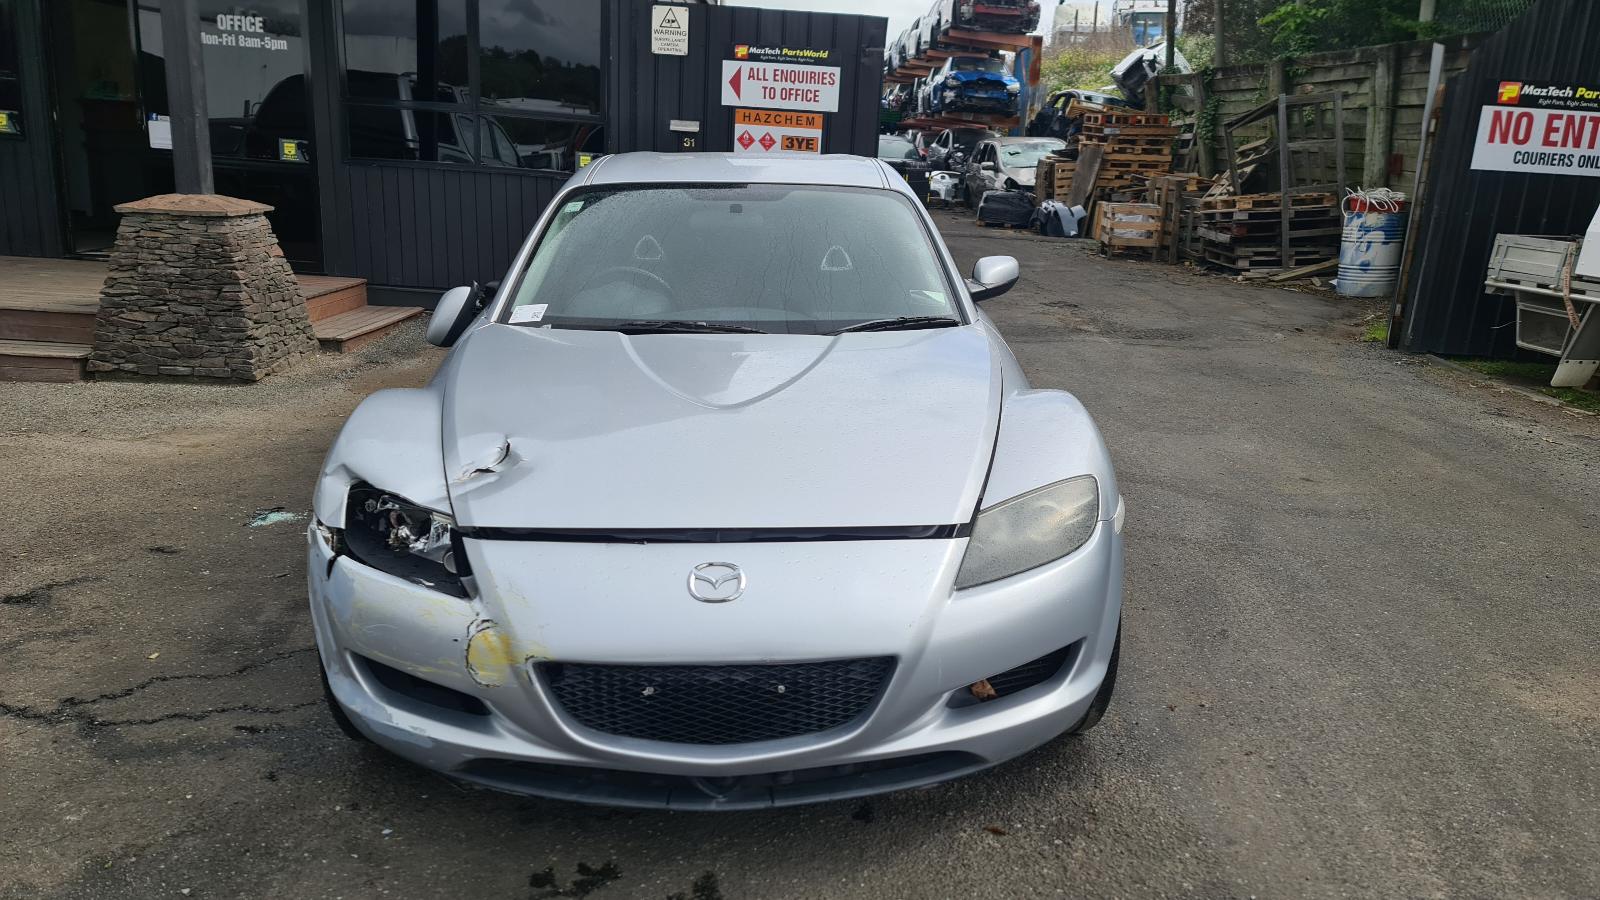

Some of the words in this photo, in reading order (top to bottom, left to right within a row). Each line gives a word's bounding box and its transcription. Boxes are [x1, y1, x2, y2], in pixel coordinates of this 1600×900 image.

[216, 13, 264, 33] OFFICE
[653, 28, 687, 37] WARNING
[238, 34, 288, 50] 8am-5pm
[782, 48, 829, 58] PartsWorld
[748, 67, 769, 82] ALL
[773, 69, 836, 86] ENQUIRIES
[762, 86, 776, 100] TO
[780, 88, 820, 103] OFFICE
[1521, 84, 1573, 98] MazTech
[1575, 87, 1600, 99] Par
[743, 112, 815, 126] HAZCHEM
[1487, 110, 1534, 145] NO
[683, 137, 695, 147] 31
[785, 136, 815, 151] 3YE
[1513, 151, 1575, 168] COURIERS
